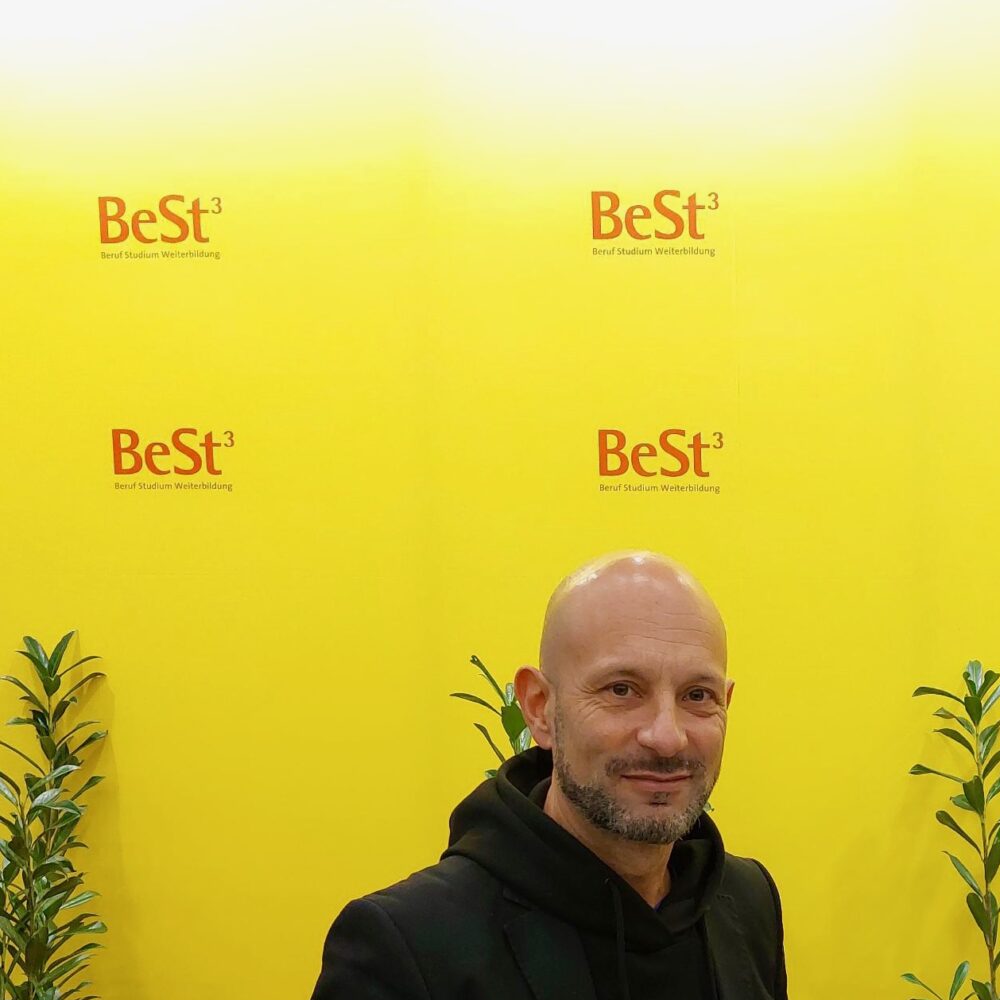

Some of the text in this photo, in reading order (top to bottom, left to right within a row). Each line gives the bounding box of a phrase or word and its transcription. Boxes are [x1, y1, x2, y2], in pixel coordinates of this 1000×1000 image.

[101, 250, 220, 259] Beruf Studium Weiterbildung
[593, 247, 715, 257] Beruf Studium Weiterbildung
[175, 481, 232, 491] Weiterbildung
[661, 484, 720, 494] Weiterbildung
